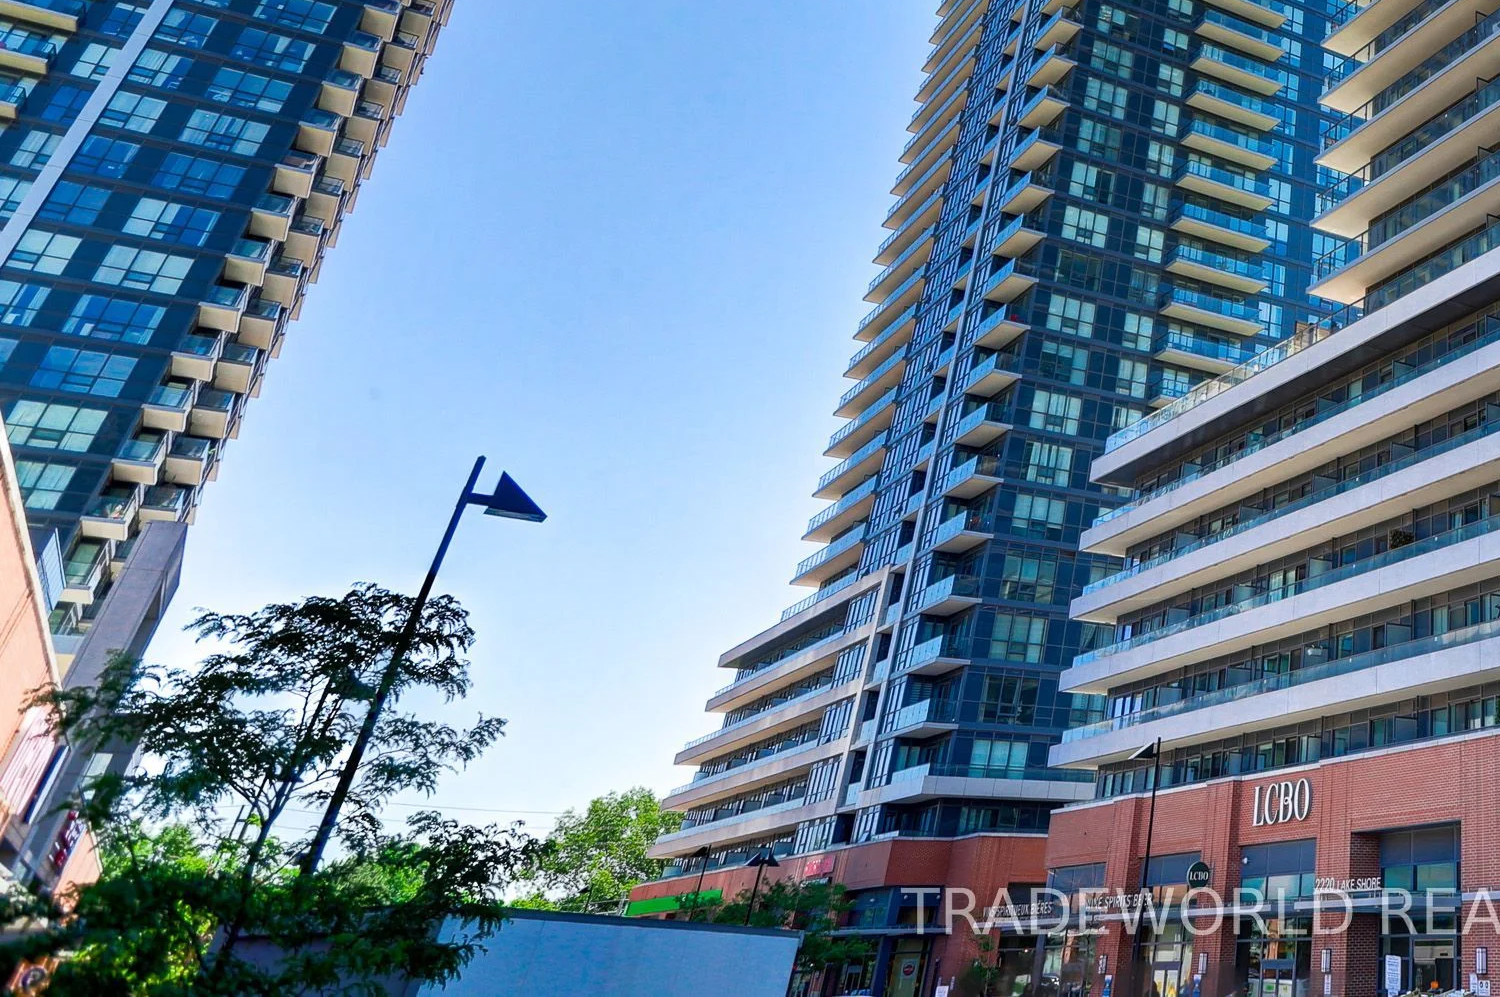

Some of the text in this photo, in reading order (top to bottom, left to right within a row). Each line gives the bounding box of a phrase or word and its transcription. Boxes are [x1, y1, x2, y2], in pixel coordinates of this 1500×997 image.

[1252, 777, 1312, 827] LCBO
[1189, 871, 1209, 881] LCBO
[1336, 879, 1355, 891] LAKE
[1356, 877, 1382, 890] SHORE
